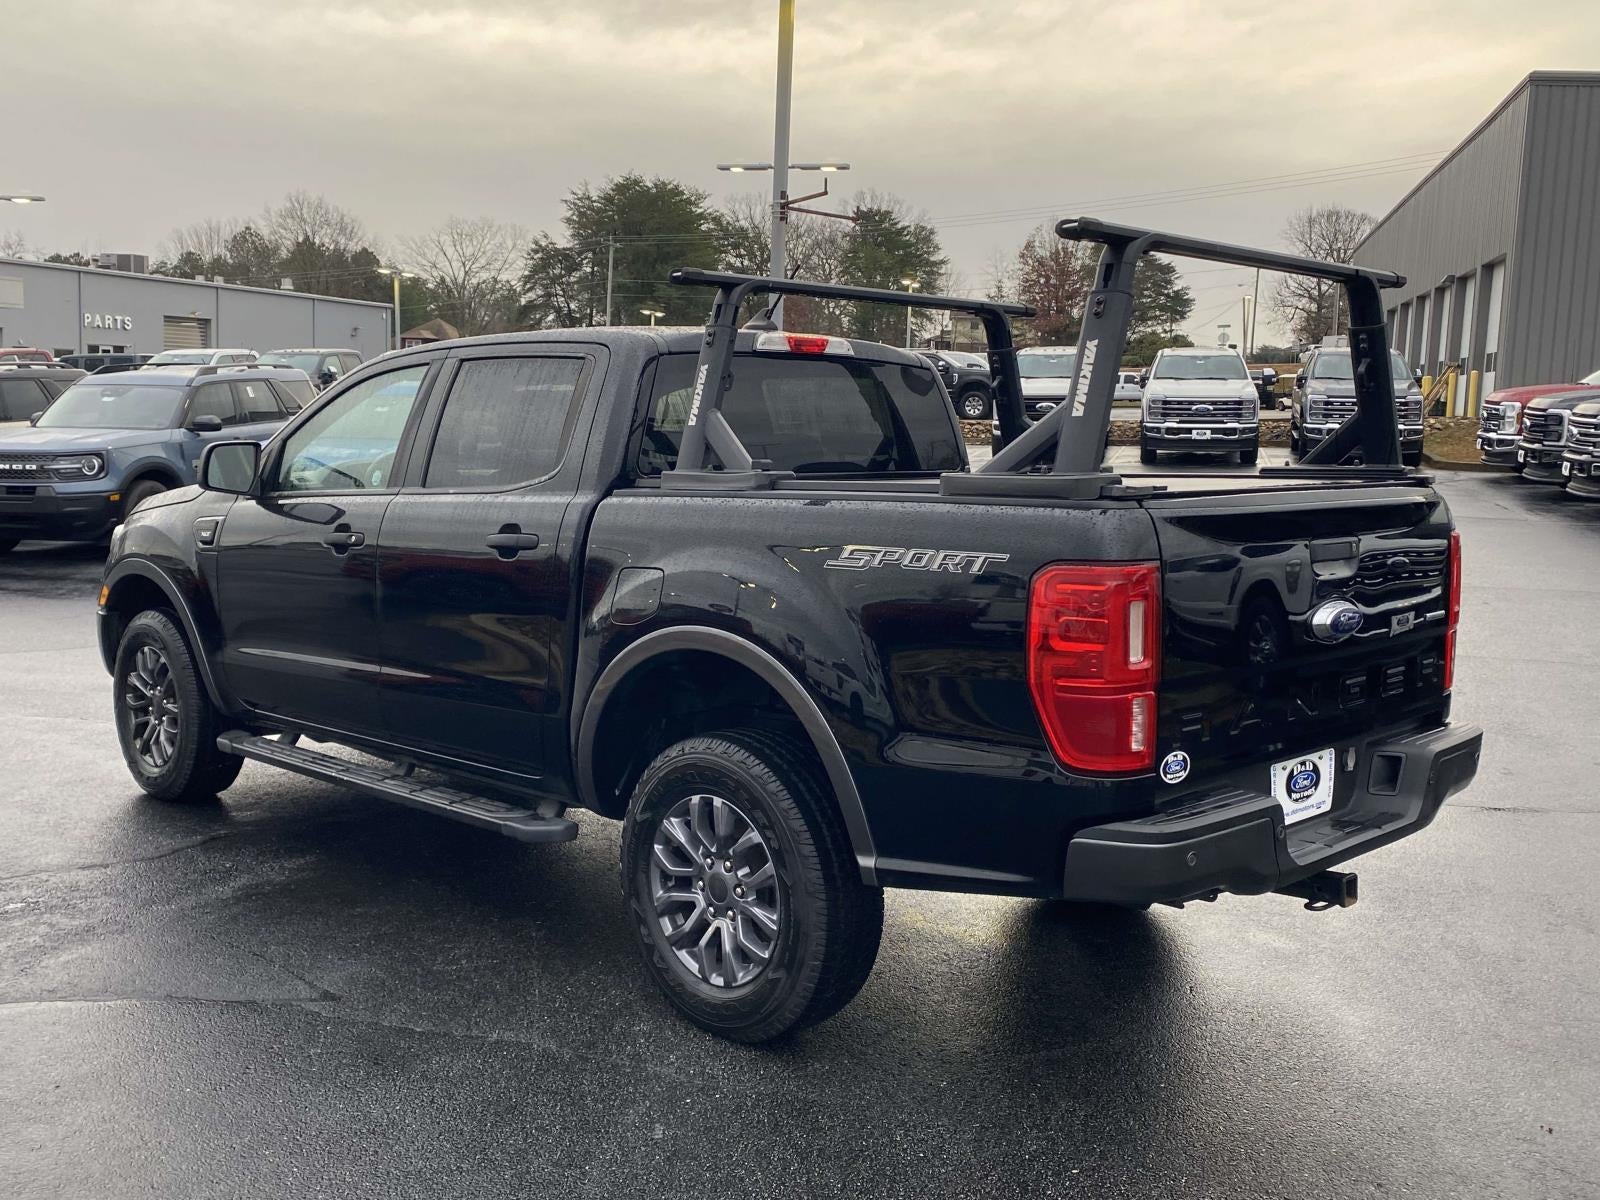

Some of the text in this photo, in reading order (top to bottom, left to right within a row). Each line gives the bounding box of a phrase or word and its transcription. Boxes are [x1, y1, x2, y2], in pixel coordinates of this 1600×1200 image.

[84, 313, 132, 330] PARTS
[1072, 339, 1098, 417] YAKIMA
[688, 364, 708, 426] YAKIMA
[823, 544, 1010, 575] SPORT
[1293, 761, 1314, 776] D&D
[1295, 774, 1312, 789] Ford
[1291, 786, 1316, 801] MOTORS
